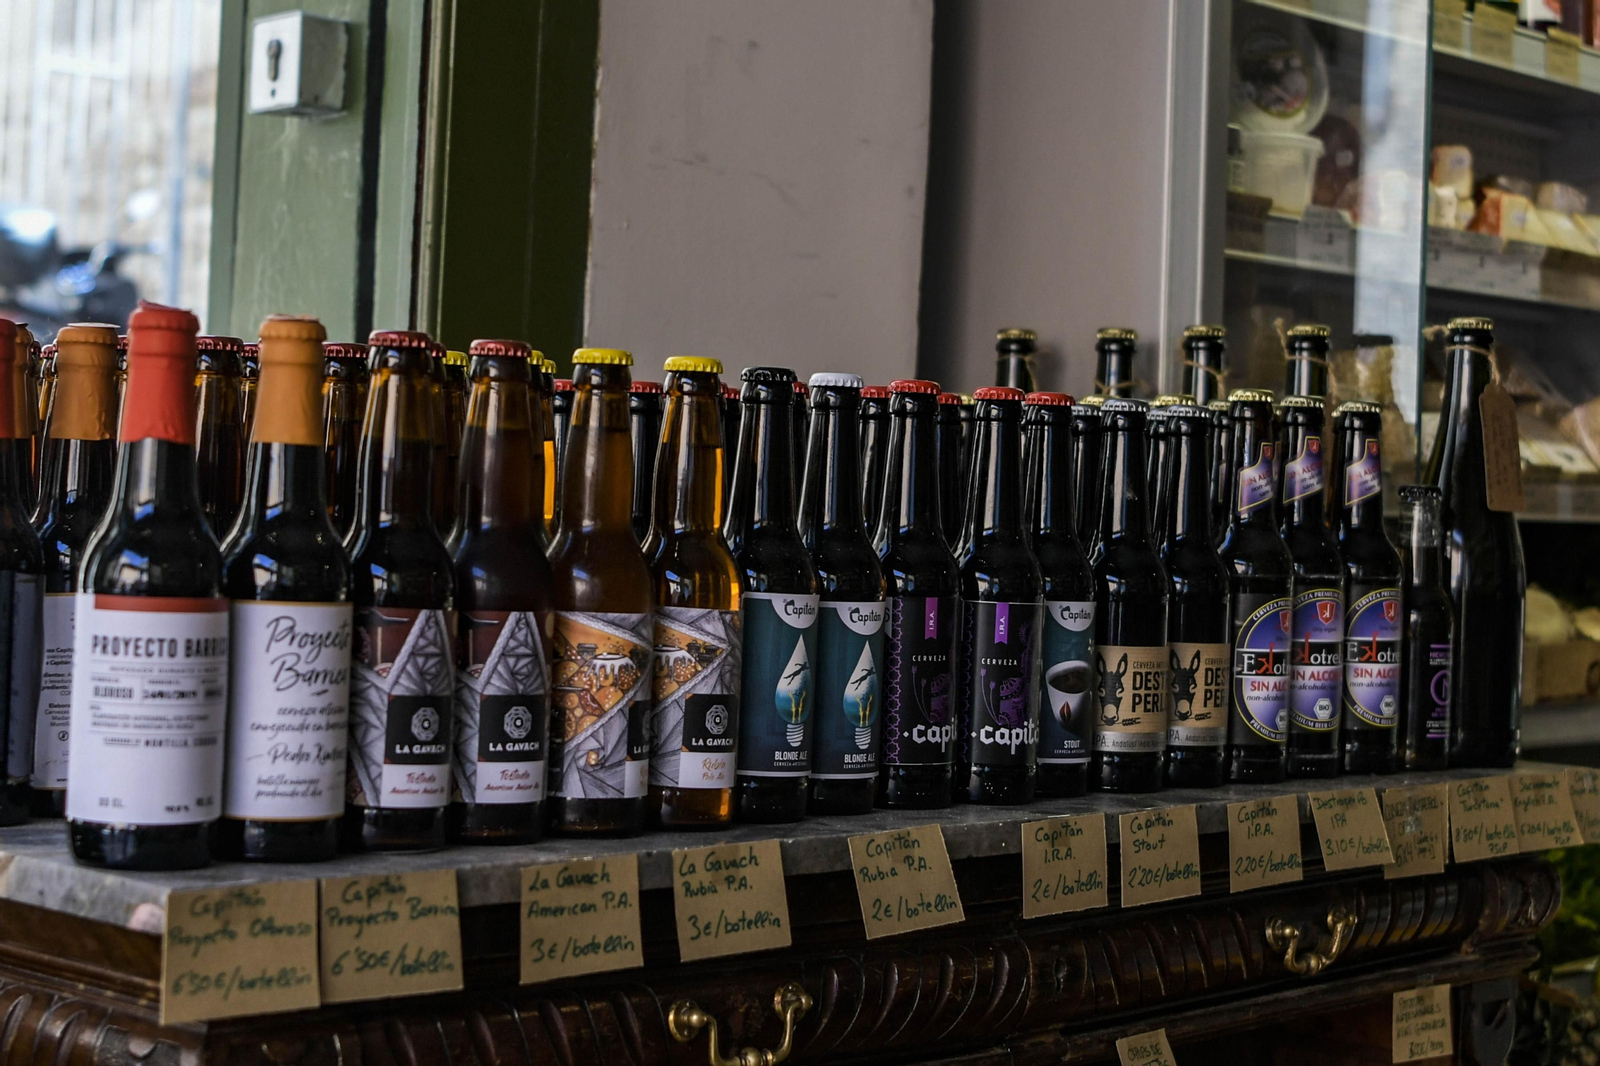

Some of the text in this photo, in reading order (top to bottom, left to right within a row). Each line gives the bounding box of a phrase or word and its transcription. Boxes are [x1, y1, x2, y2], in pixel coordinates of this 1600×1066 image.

[784, 599, 816, 619] Capitán
[1355, 592, 1380, 610] CERVEZA
[849, 607, 881, 626] Capitán
[1060, 605, 1092, 623] Capitán
[1252, 602, 1278, 621] CERVEZA
[92, 634, 178, 659] PROYECTO
[911, 654, 947, 662] CERVEZA
[981, 657, 1018, 666] CERVEZA
[1132, 661, 1155, 669] CERVEZA
[1353, 667, 1373, 678] SIN
[1250, 681, 1269, 692] SIN
[1318, 703, 1330, 712] BIO
[1353, 704, 1380, 724] PREMIUM
[1249, 718, 1276, 738] PREMIUM
[395, 744, 411, 754] LA
[489, 742, 503, 752] LA
[691, 738, 704, 746] LA
[1063, 739, 1081, 749] STOUT
[774, 750, 808, 760] BLONDE ALE
[844, 752, 876, 763] BLONDE ALE
[1237, 801, 1278, 827] Capitán
[1330, 812, 1348, 829] IPA
[1130, 812, 1174, 837] Capitán
[1247, 822, 1274, 840] I.P.A.
[1035, 821, 1083, 848] Capitán
[1132, 833, 1166, 854] Stout
[866, 831, 921, 859] Capitán
[679, 846, 759, 876] La Gavach
[1044, 847, 1076, 864] I.R.A.
[529, 862, 611, 892] La Gavach
[860, 855, 933, 883] Rubia P.A.
[341, 875, 406, 909] Capitán
[682, 875, 754, 898] Rubia P.A.
[527, 891, 633, 918] American P.A.
[324, 900, 400, 939] Proyecto
[168, 920, 238, 959] Proyecto
